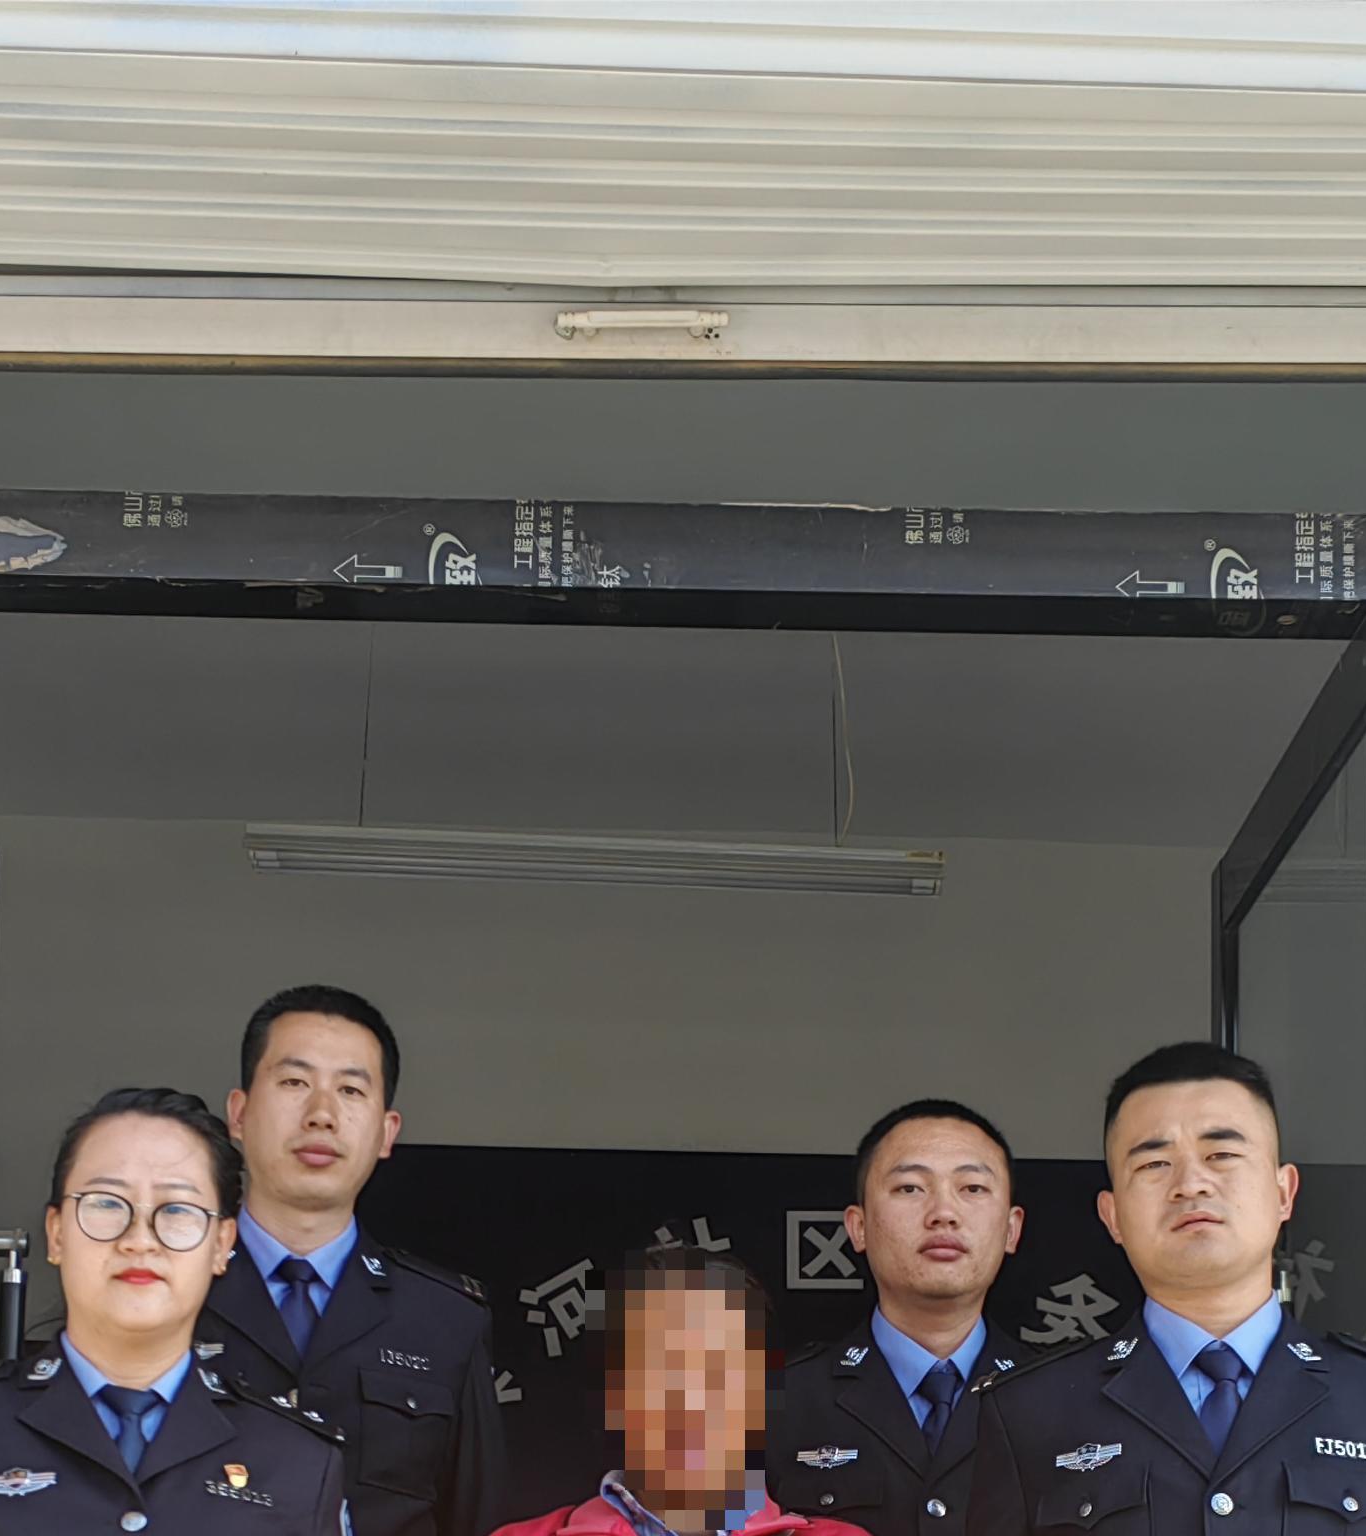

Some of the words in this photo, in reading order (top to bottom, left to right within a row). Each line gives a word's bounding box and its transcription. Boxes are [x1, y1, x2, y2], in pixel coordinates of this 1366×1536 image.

[147, 495, 162, 527] 通过
[514, 499, 535, 569] 工程指定
[539, 500, 554, 587] 际质量体系
[929, 512, 943, 544] 通过
[1320, 512, 1334, 600] 际质量体系
